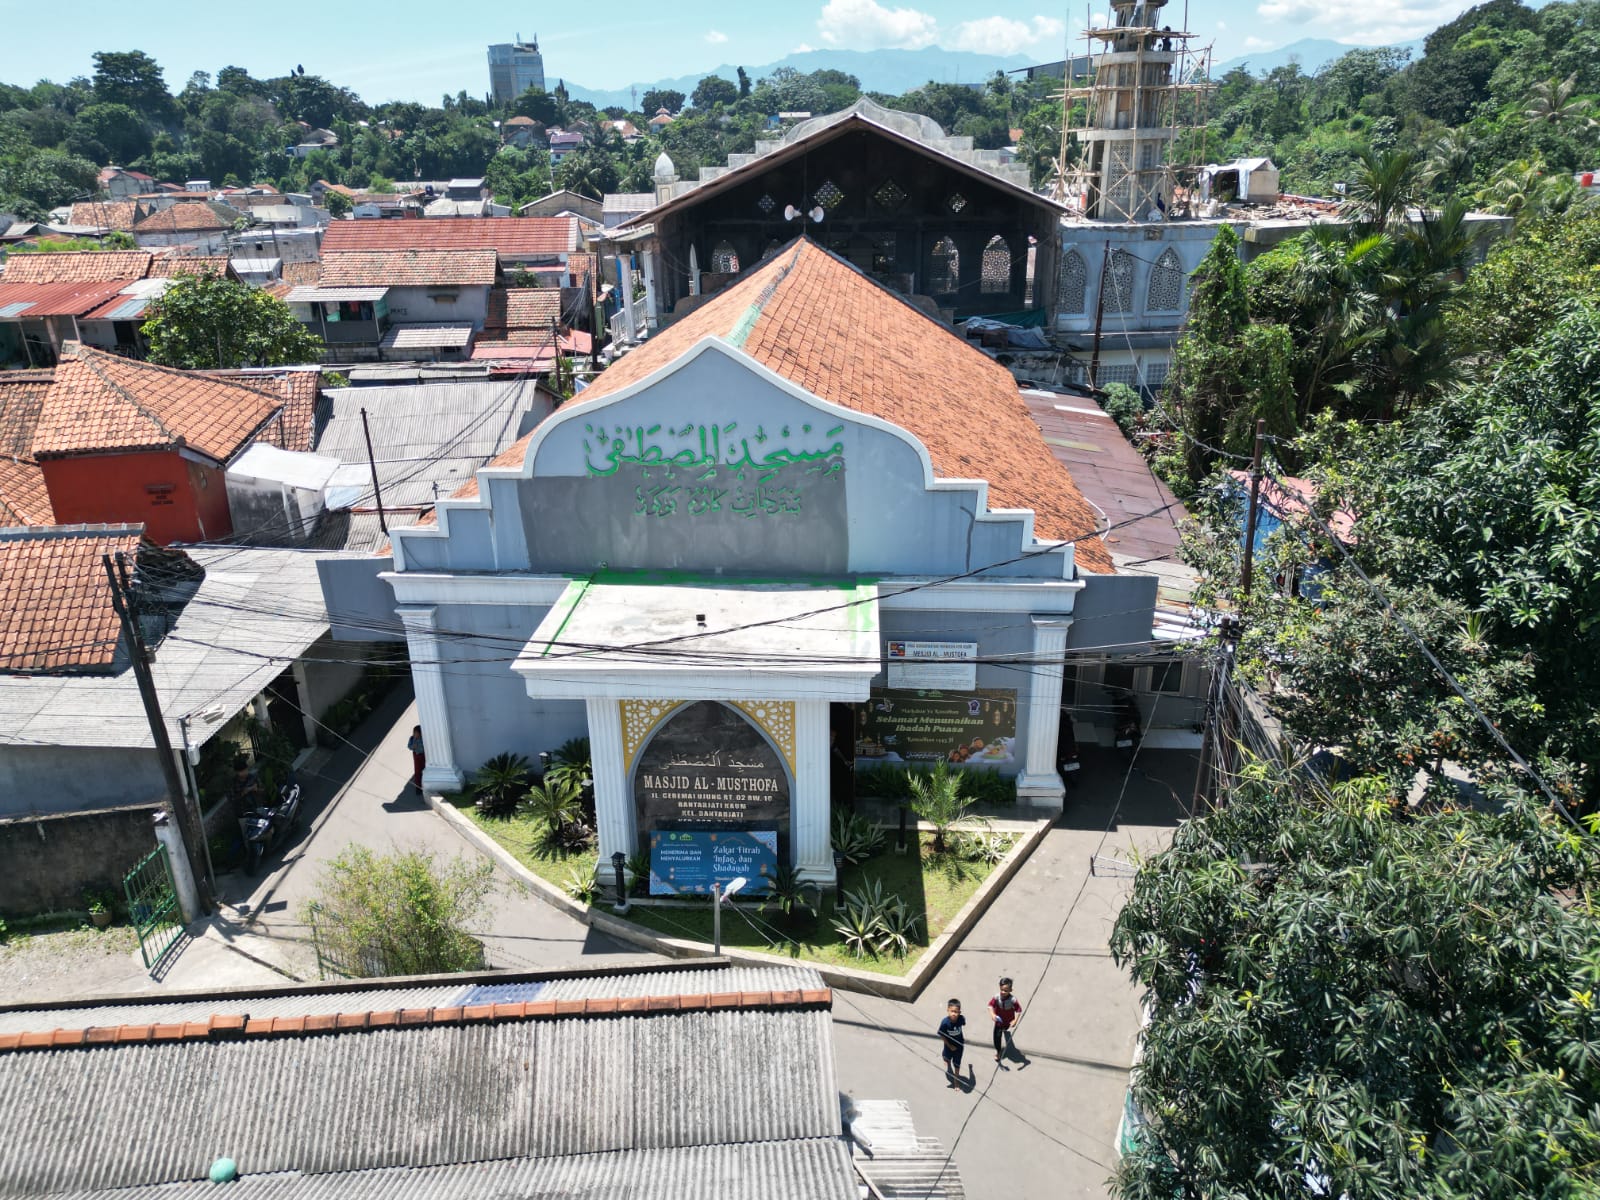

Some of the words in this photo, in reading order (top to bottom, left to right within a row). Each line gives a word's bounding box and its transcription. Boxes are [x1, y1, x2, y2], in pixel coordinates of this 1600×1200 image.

[919, 716, 984, 725] Menunaikan
[644, 775, 690, 789] MASJID
[694, 776, 709, 790] AL
[717, 777, 779, 792] MUSTHOFA
[713, 846, 735, 854] Zakat
[736, 846, 760, 855] Fitrah
[738, 855, 752, 863] dan
[712, 864, 751, 874] Shadaqah
